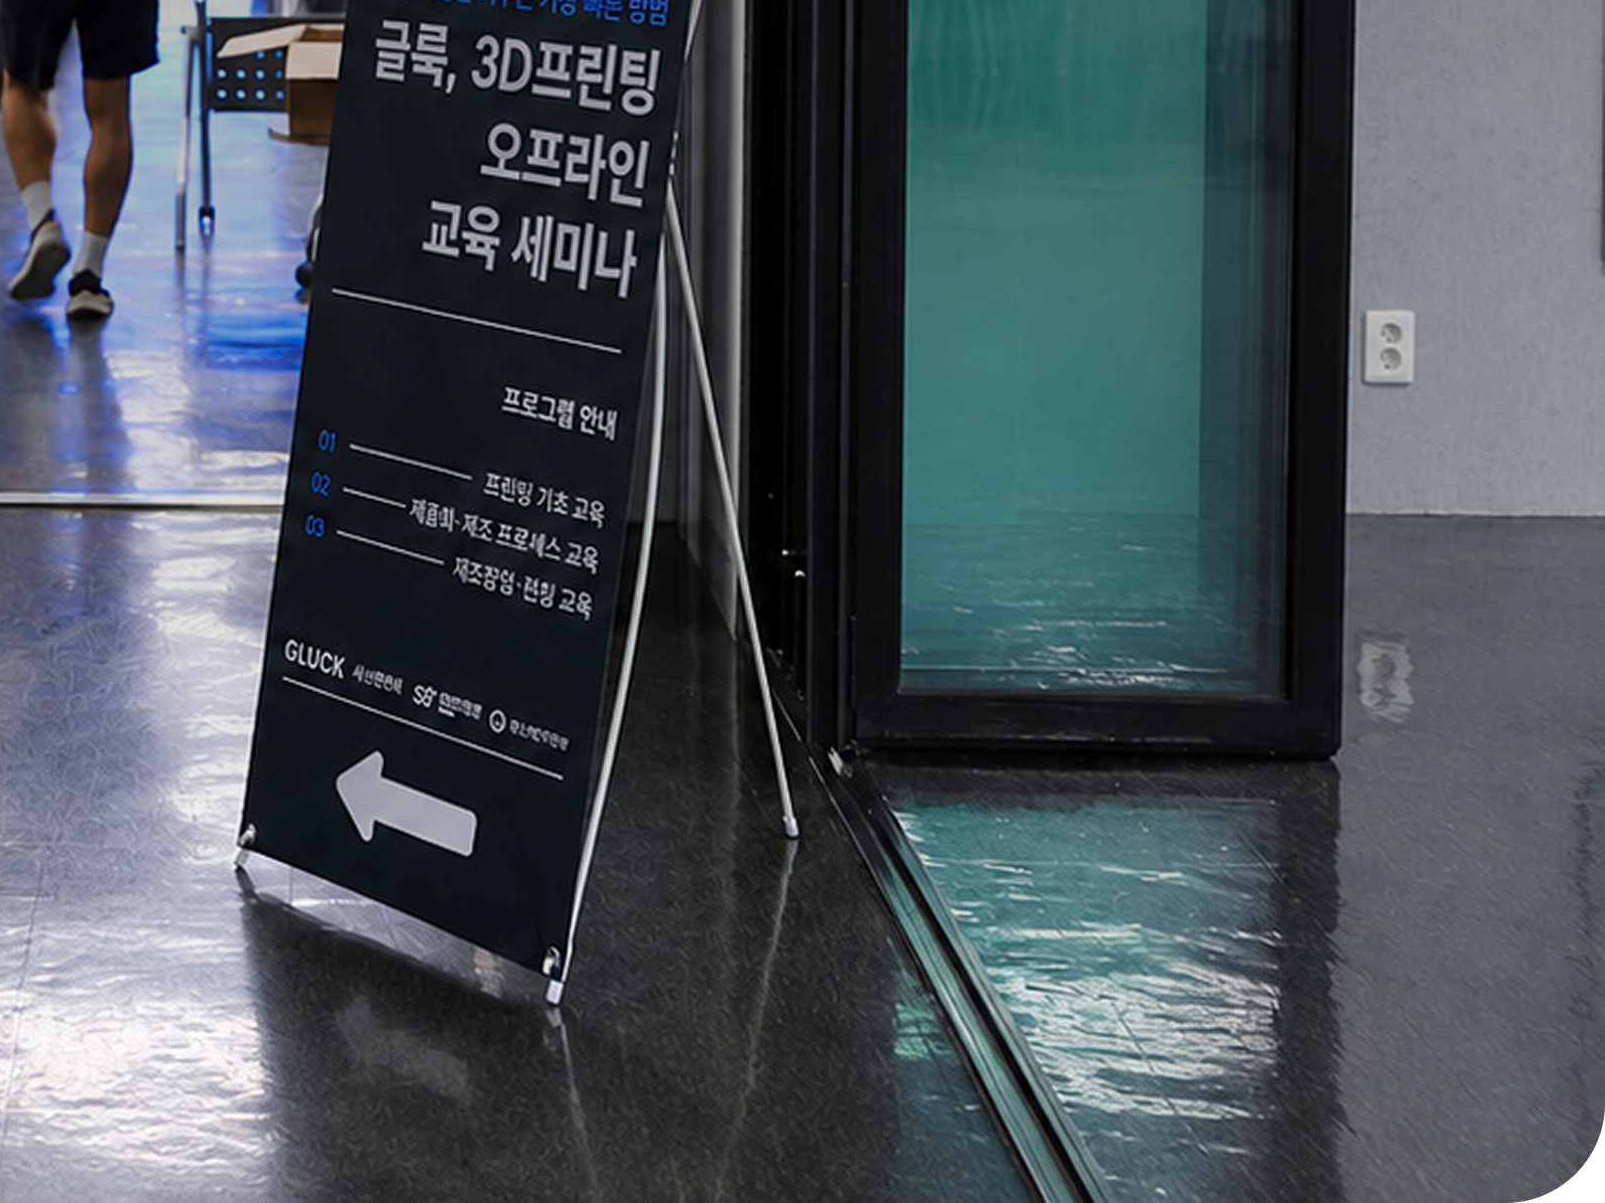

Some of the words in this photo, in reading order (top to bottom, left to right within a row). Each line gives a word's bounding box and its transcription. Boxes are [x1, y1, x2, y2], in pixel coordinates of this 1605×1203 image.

[375, 19, 457, 95] 글룩,
[471, 34, 661, 116] 3D프린팅
[480, 122, 650, 208] 오프라인
[422, 199, 501, 272] 교육
[510, 212, 638, 299] 세미나
[501, 385, 575, 432] 프로그램
[579, 404, 618, 442] 안내
[318, 429, 337, 453] 01
[310, 472, 332, 496] 02
[304, 514, 325, 538] 03
[537, 486, 569, 515] 기초
[570, 497, 607, 529] 교육
[564, 540, 600, 575] 교육
[558, 588, 594, 622] 교육
[284, 639, 345, 680] GLUCK
